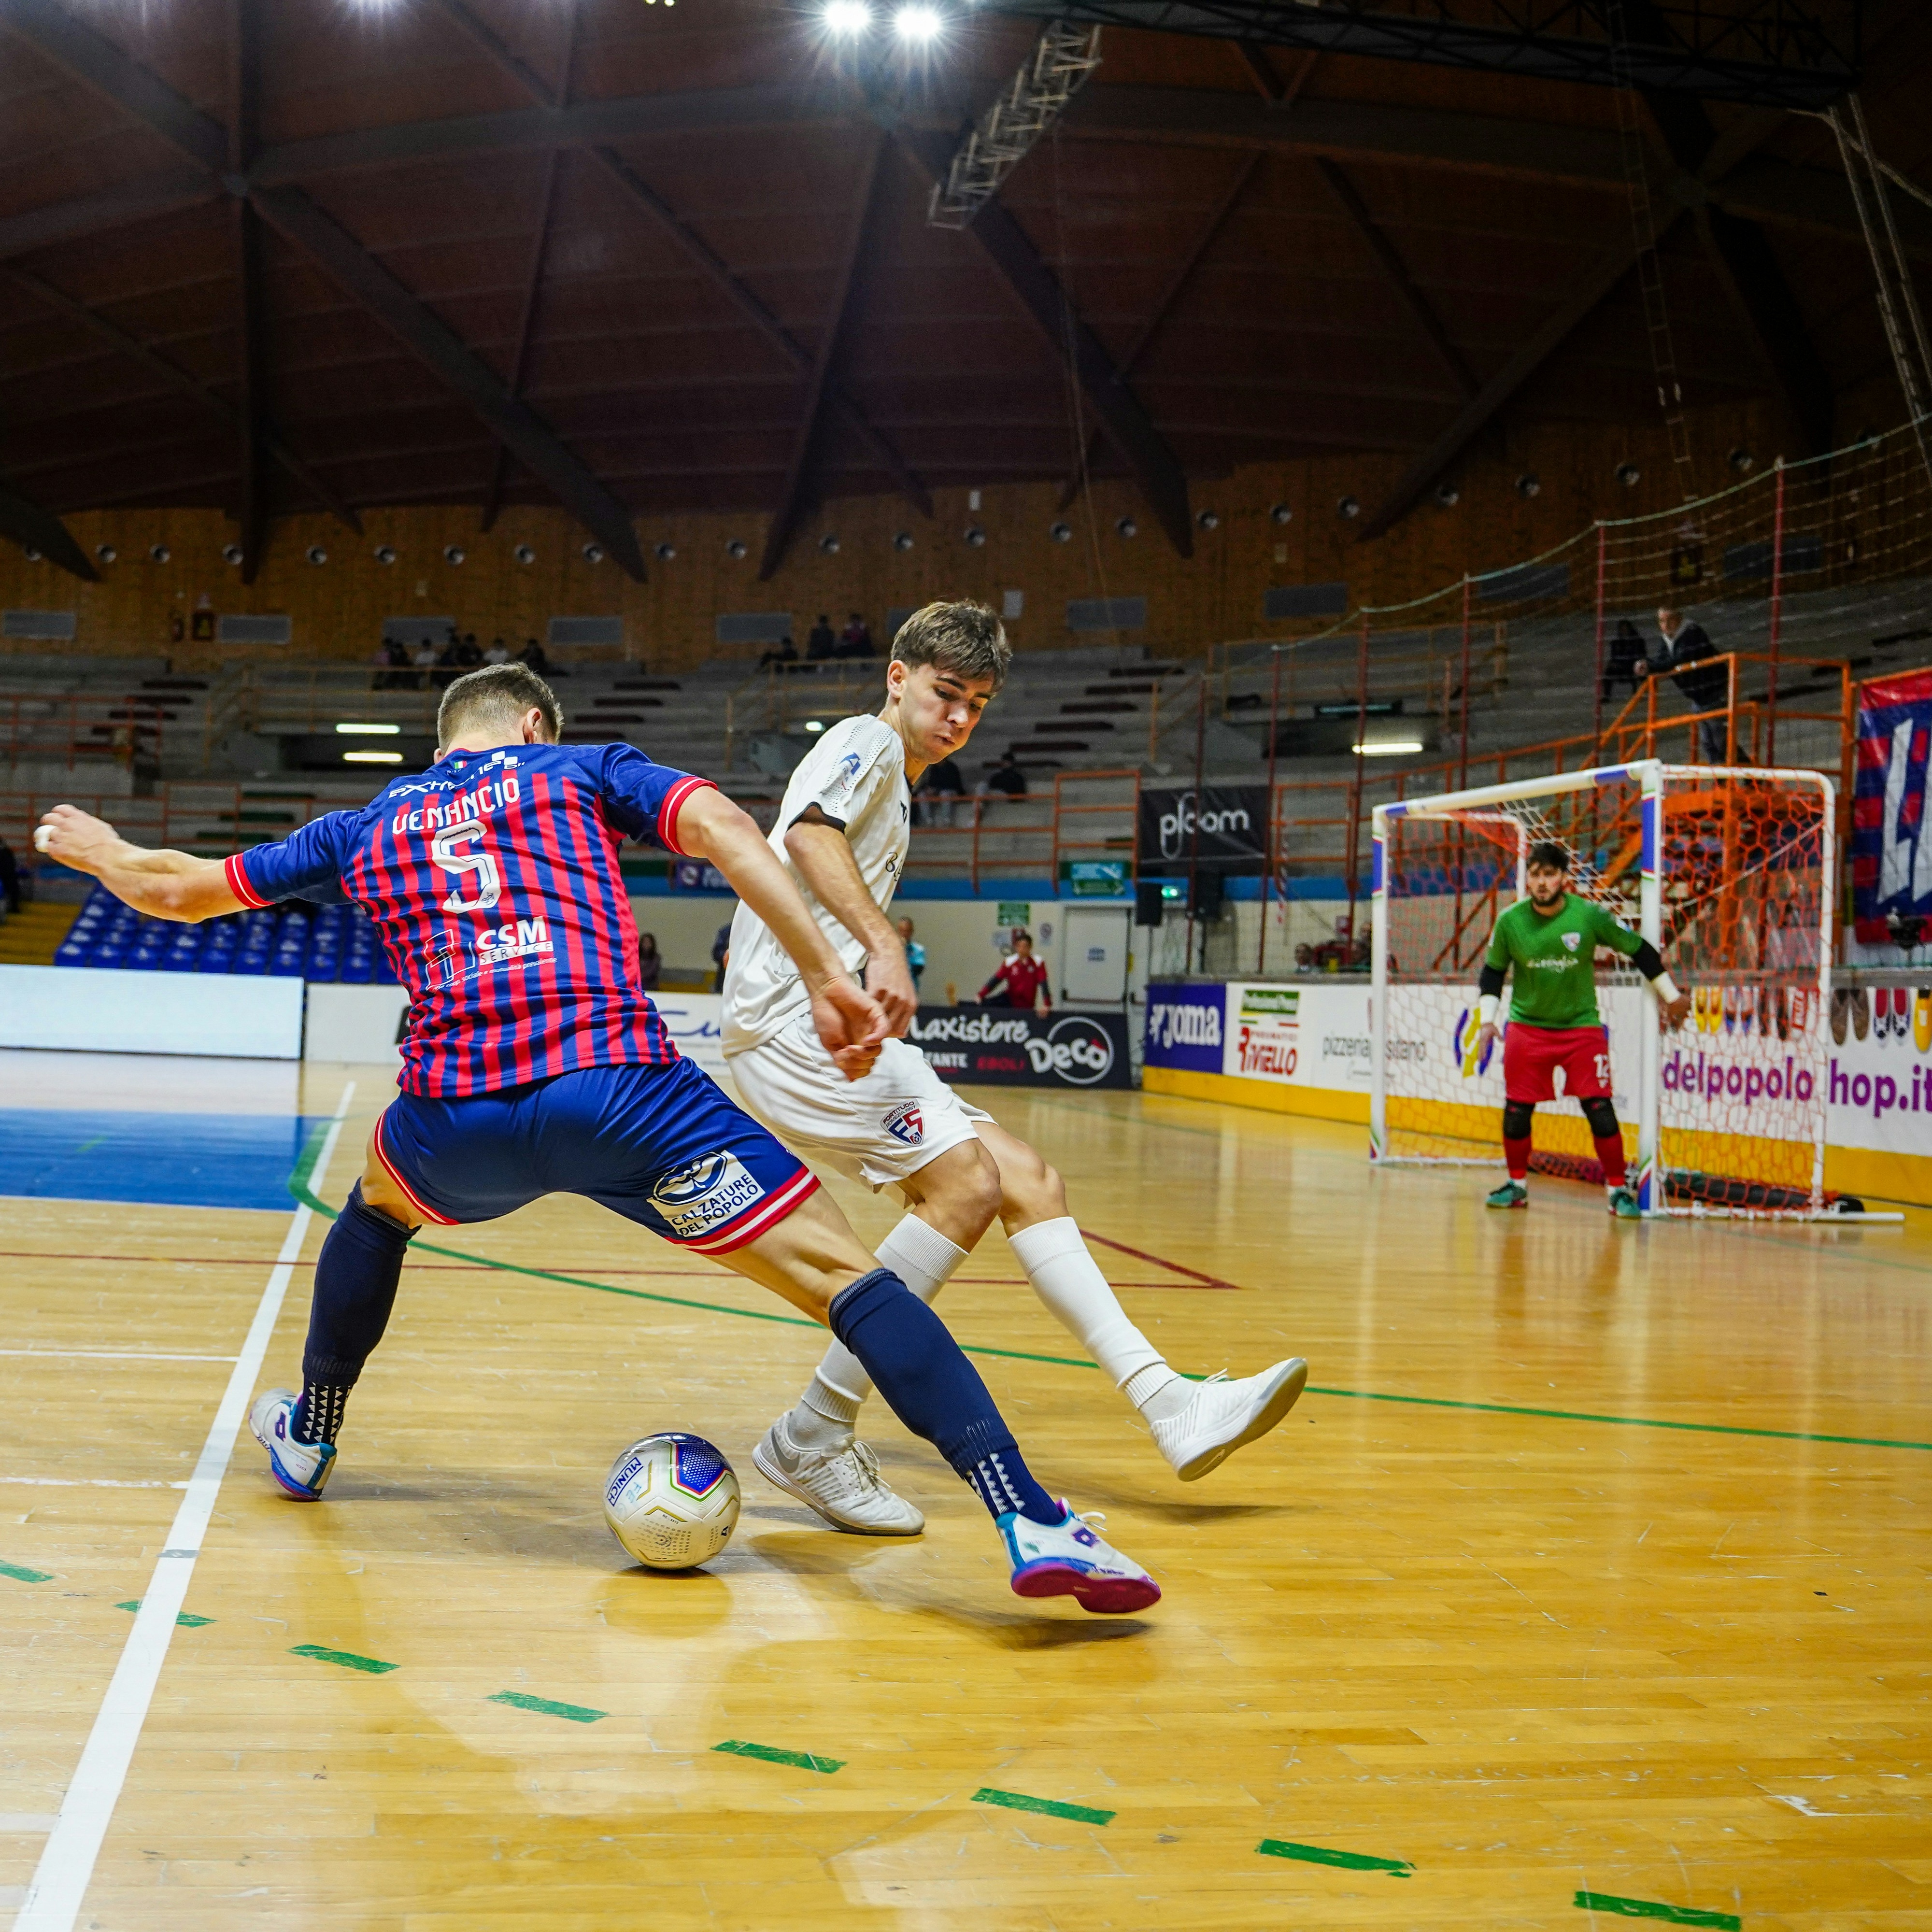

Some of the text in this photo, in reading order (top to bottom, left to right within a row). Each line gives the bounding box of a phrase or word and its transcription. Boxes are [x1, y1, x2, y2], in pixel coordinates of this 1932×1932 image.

[431, 819, 501, 914] 5
[476, 915, 547, 950] CSM
[480, 943, 552, 964] SERVICE
[1662, 1050, 1932, 1118] delpopolohop.it
[883, 1101, 914, 1124] FORTITUDO
[671, 1174, 752, 1226] CALZATURE
[679, 1184, 758, 1235] DEL POPOLO
[608, 1456, 642, 1507] MUNICH
